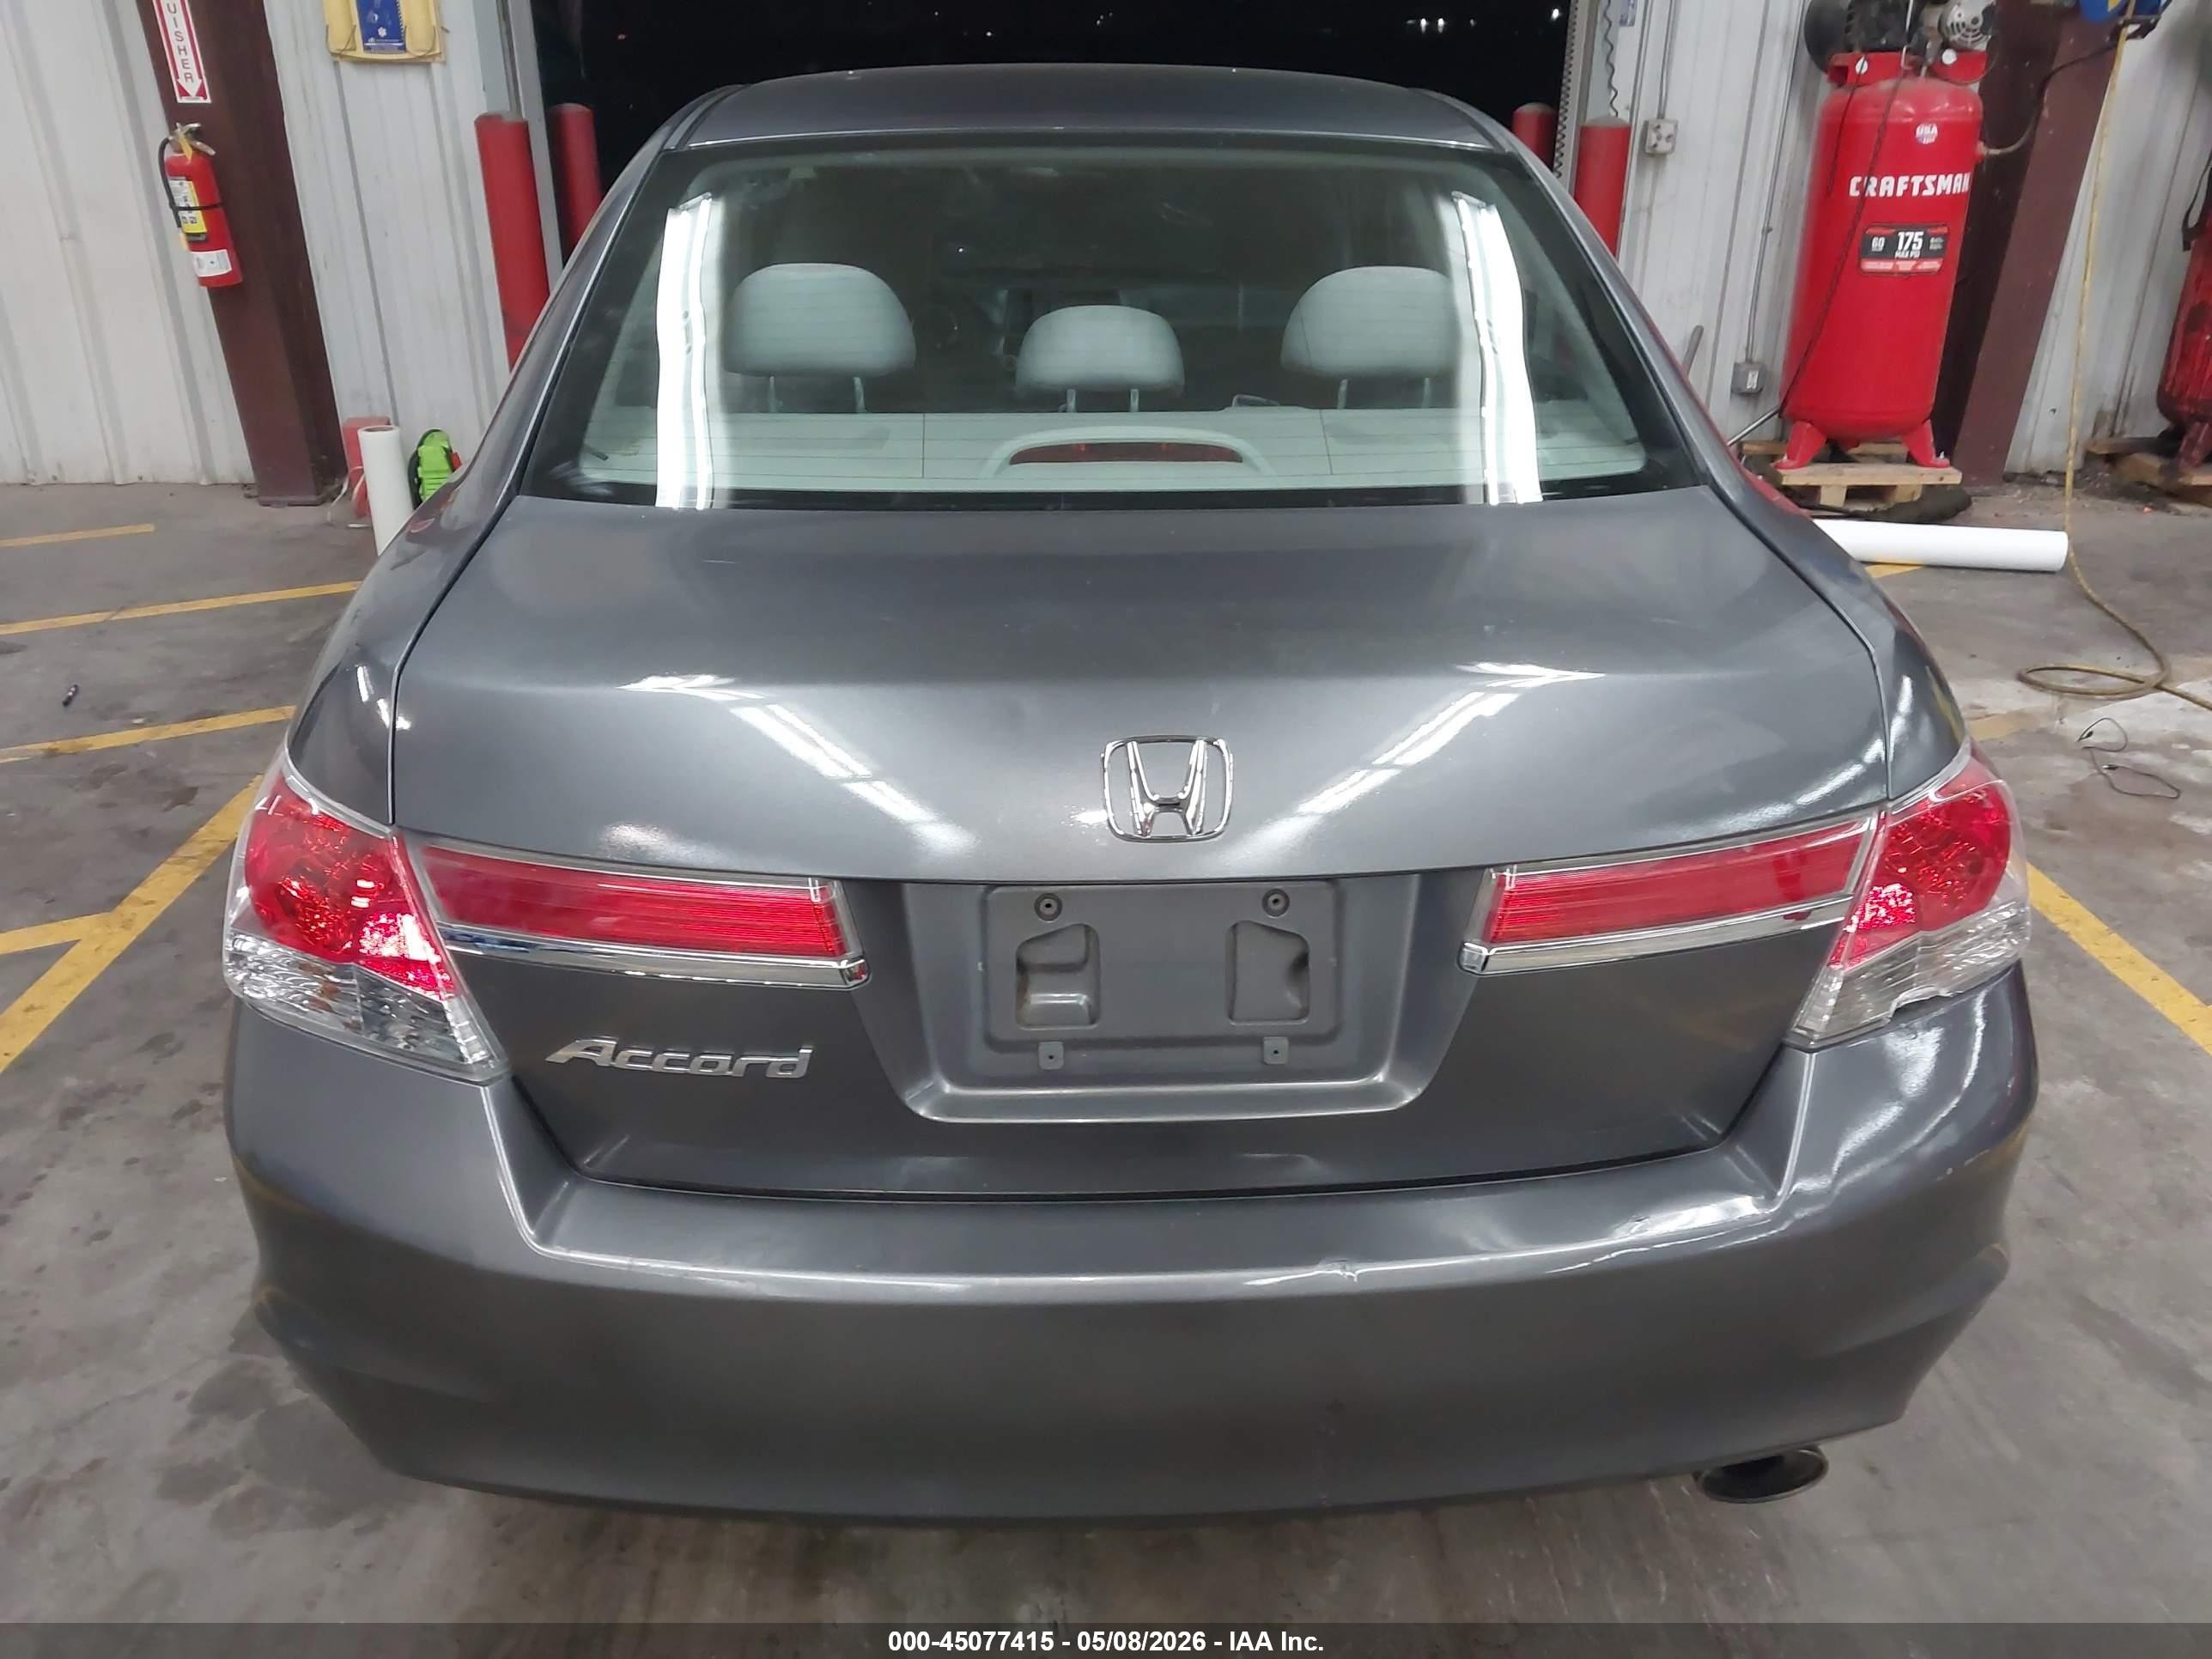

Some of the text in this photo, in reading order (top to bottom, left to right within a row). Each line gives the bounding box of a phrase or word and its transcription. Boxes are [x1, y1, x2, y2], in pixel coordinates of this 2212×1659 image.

[1849, 173, 1971, 197] CRAFTSMAN
[1871, 236, 1886, 248] 60
[1898, 231, 1924, 250] 175
[545, 1036, 813, 1079] Accord
